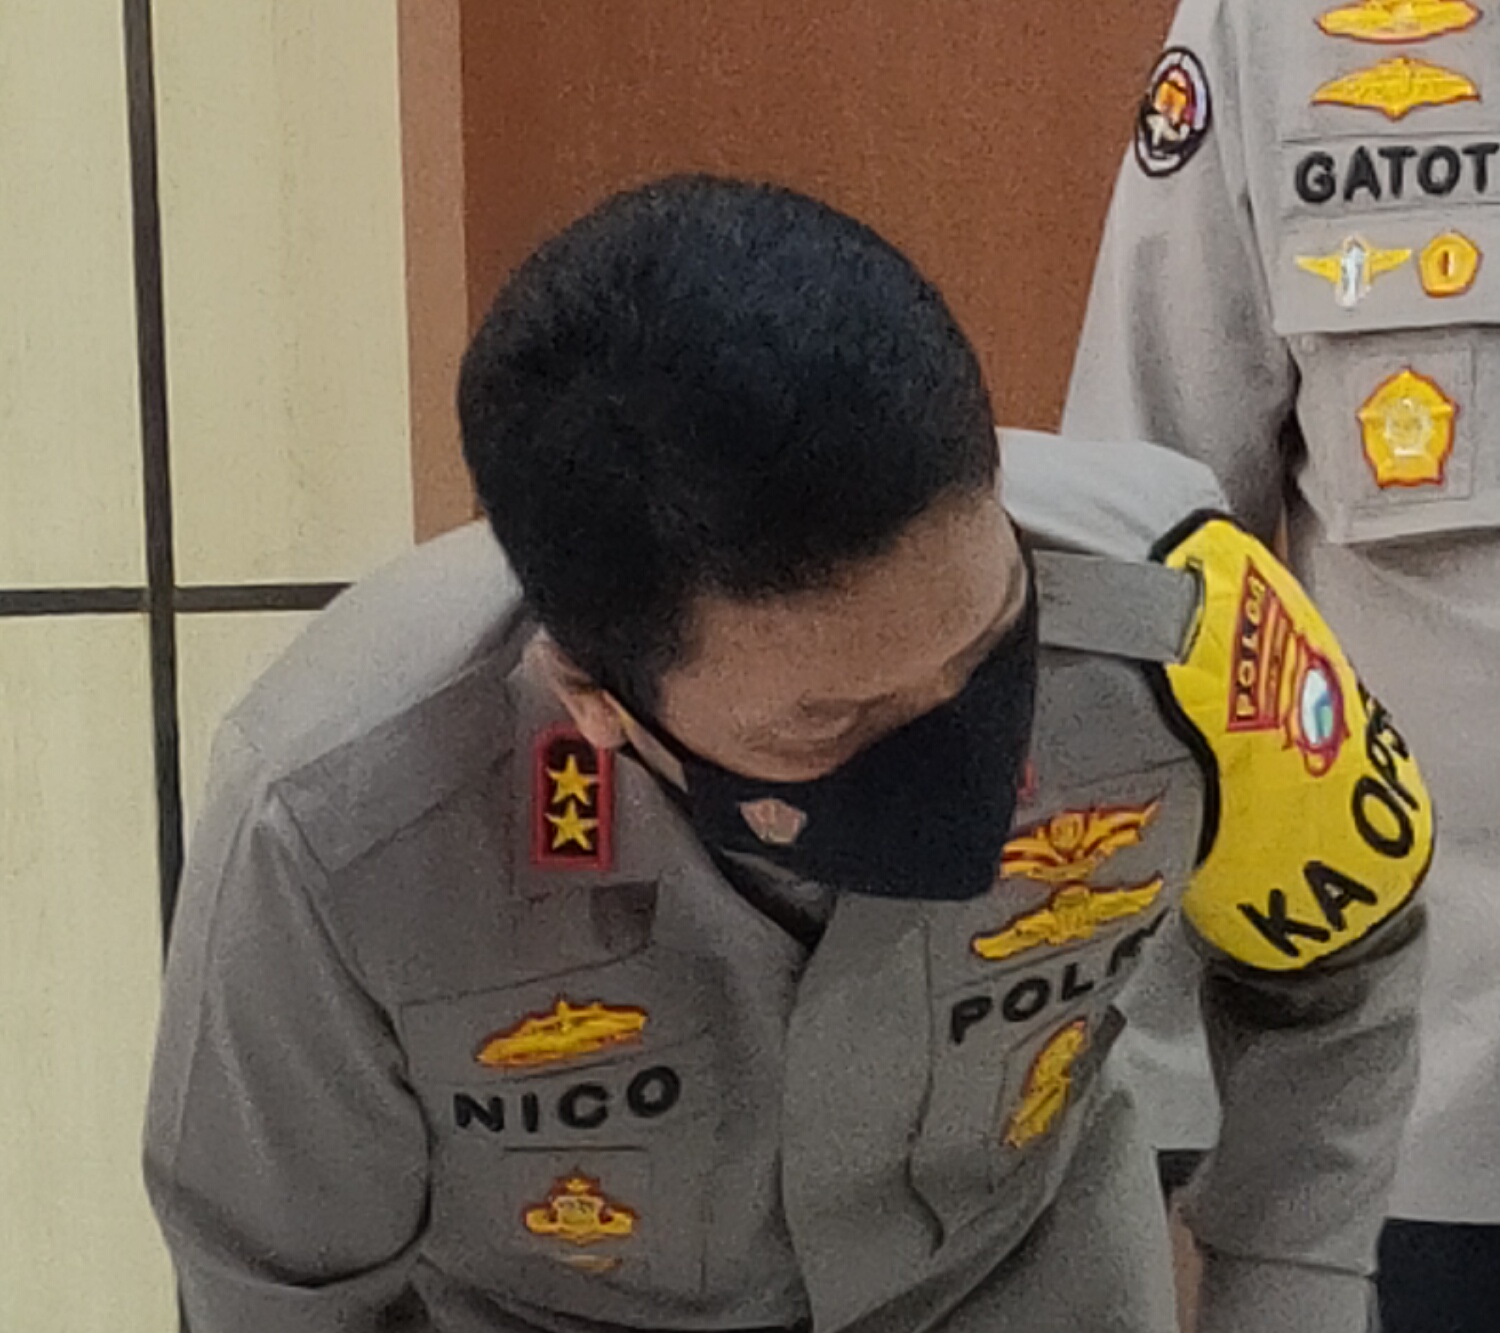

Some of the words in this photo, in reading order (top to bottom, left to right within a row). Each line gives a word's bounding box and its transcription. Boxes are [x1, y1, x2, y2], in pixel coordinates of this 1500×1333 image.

[1294, 142, 1500, 204] GATOT
[1236, 861, 1378, 958] KA
[453, 1065, 681, 1133] NICO
